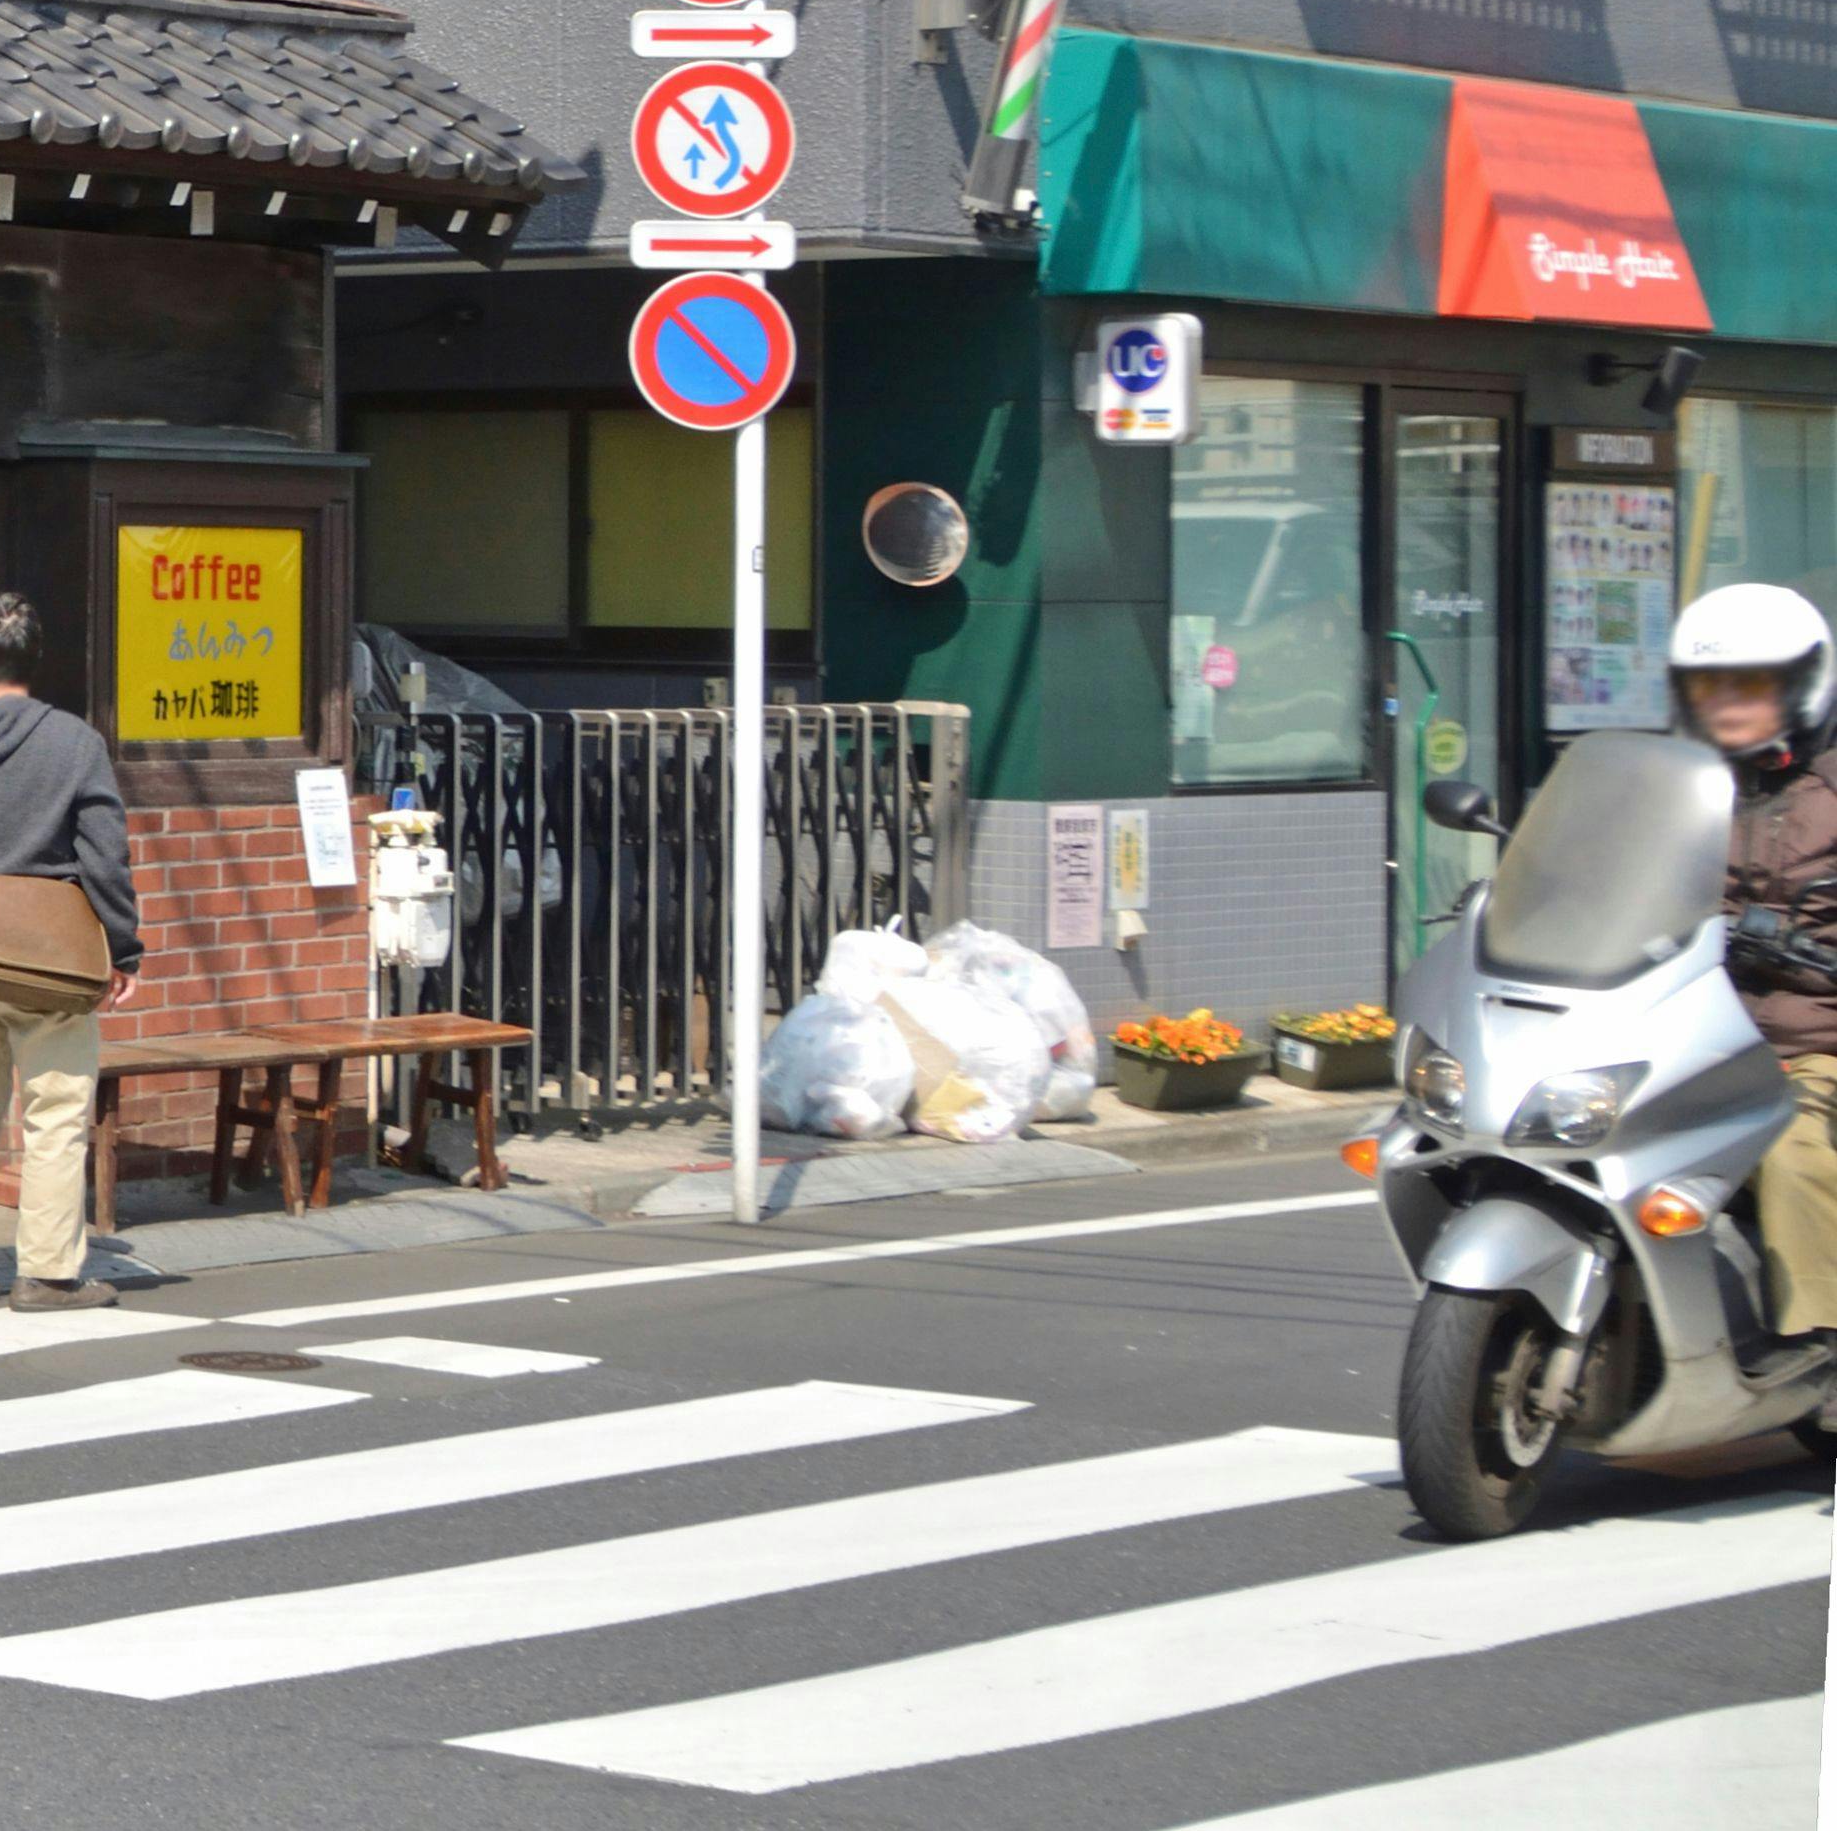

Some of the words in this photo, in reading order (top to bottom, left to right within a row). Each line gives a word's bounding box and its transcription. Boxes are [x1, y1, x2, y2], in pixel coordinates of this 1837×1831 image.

[1111, 344, 1166, 378] UC
[152, 555, 262, 601] Coffee
[169, 619, 275, 661] あんみつ
[152, 680, 261, 721] カヤバ珈琲
